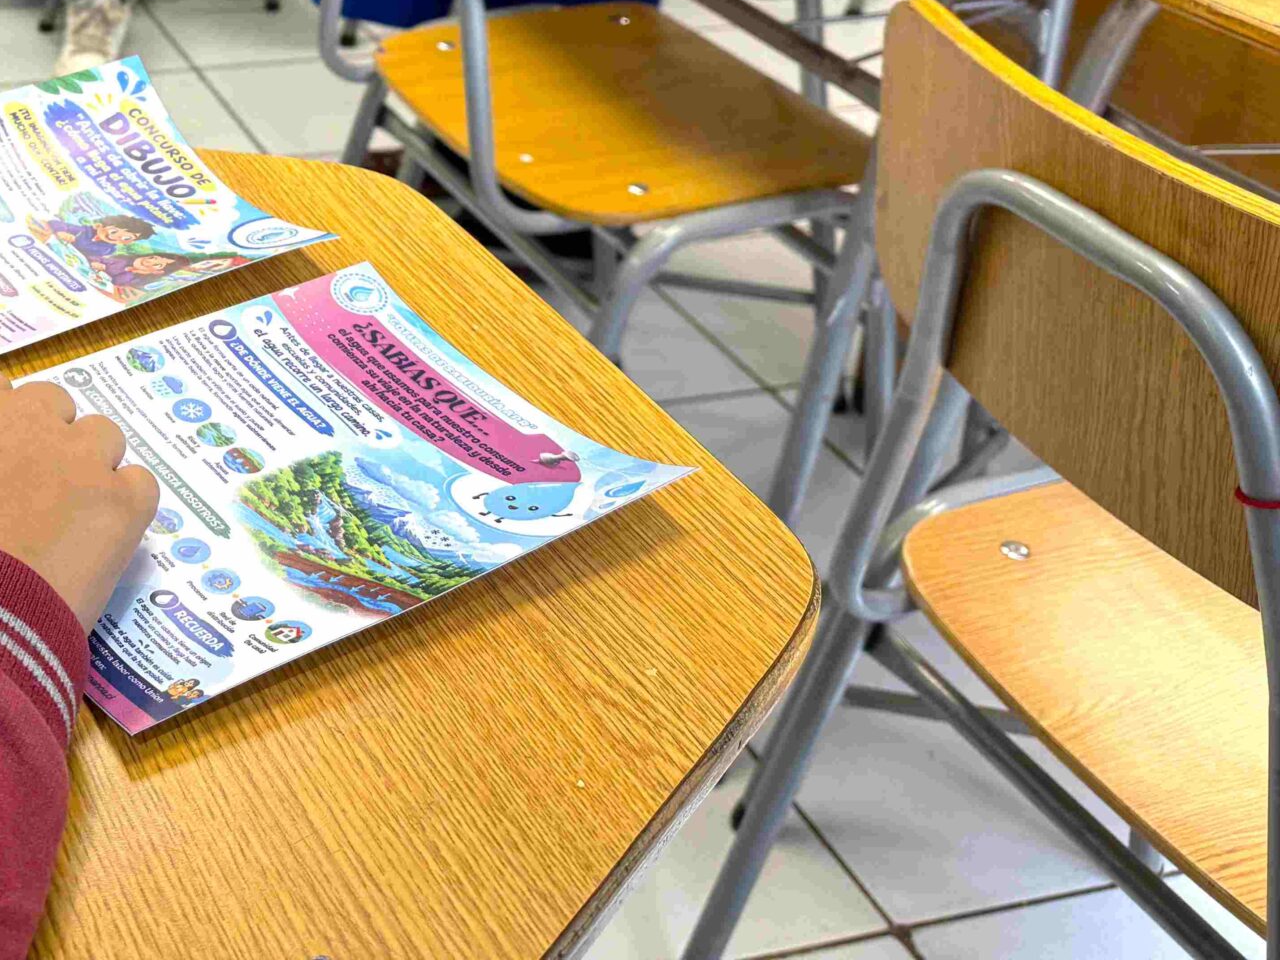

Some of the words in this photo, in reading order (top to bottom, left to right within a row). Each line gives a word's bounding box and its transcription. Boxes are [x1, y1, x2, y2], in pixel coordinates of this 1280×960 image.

[100, 112, 197, 198] DIBUJO
[129, 108, 194, 171] CONCURSO
[190, 172, 211, 185] DE
[229, 342, 248, 355] ¿DE
[244, 355, 271, 379] DÓNDE
[267, 378, 291, 398] VIENE
[286, 397, 299, 406] EL
[296, 406, 325, 427] AGUA?
[253, 328, 267, 337] el
[262, 338, 283, 357] agua
[281, 357, 310, 382] recorre
[308, 383, 322, 393] un
[318, 393, 342, 412] largo
[340, 411, 370, 436] camino.
[279, 327, 300, 346] Antes
[299, 347, 310, 356] de
[308, 355, 329, 372] llegar
[332, 378, 362, 403] nuestras
[361, 403, 383, 422] casas,
[281, 342, 309, 369] escuelas
[353, 323, 438, 389] ¿SABÍAS
[327, 333, 367, 369] comienza
[365, 369, 379, 379] su
[377, 377, 400, 396] viaje
[397, 395, 412, 405] en
[408, 403, 421, 413] la
[419, 412, 472, 451] naturaleza
[467, 450, 481, 458] y
[478, 456, 511, 476] desde
[337, 328, 351, 336] el
[345, 336, 368, 356] agua
[366, 355, 385, 370] que
[382, 369, 419, 397] usamos
[414, 396, 442, 416] para
[440, 414, 480, 443] nuestro
[478, 443, 525, 472] consumo
[375, 390, 402, 412] hacia
[400, 410, 414, 421] tu
[411, 420, 445, 442] casa?
[128, 437, 139, 446] EL
[136, 446, 158, 465] AGUA
[155, 464, 180, 487] HASTA
[178, 487, 223, 529] NOSOTROS?
[103, 612, 119, 629] Cuidar
[122, 635, 136, 648] agua
[134, 647, 153, 665] también
[157, 668, 174, 681] cuidar
[132, 617, 151, 638] nuestras
[132, 607, 149, 624] recorre
[147, 623, 155, 631] un
[153, 630, 170, 645] camino
[171, 647, 185, 658] llega
[183, 655, 197, 667] hasta
[140, 603, 153, 616] agua
[151, 615, 162, 625] que
[160, 624, 178, 641] usamos
[177, 640, 190, 651] tiene
[174, 610, 222, 649] RECUERDA
[112, 659, 130, 675] labor
[128, 676, 146, 690] como
